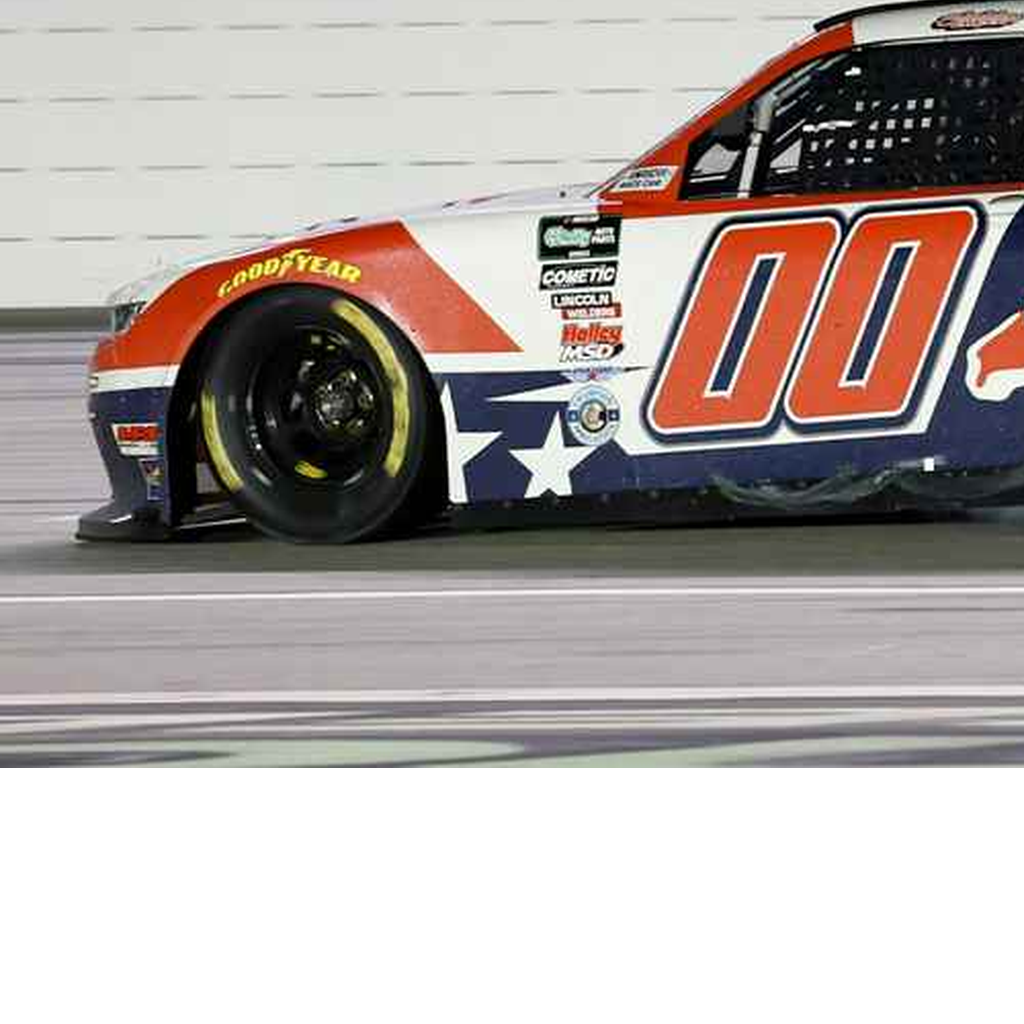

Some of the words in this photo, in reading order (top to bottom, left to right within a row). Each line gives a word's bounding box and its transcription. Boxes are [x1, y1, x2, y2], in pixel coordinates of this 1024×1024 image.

[217, 248, 361, 297] GOODYEAR
[542, 264, 616, 285] COMETIC
[553, 293, 611, 305] LINCOLN
[648, 204, 980, 436] 00
[560, 343, 614, 363] MSD
